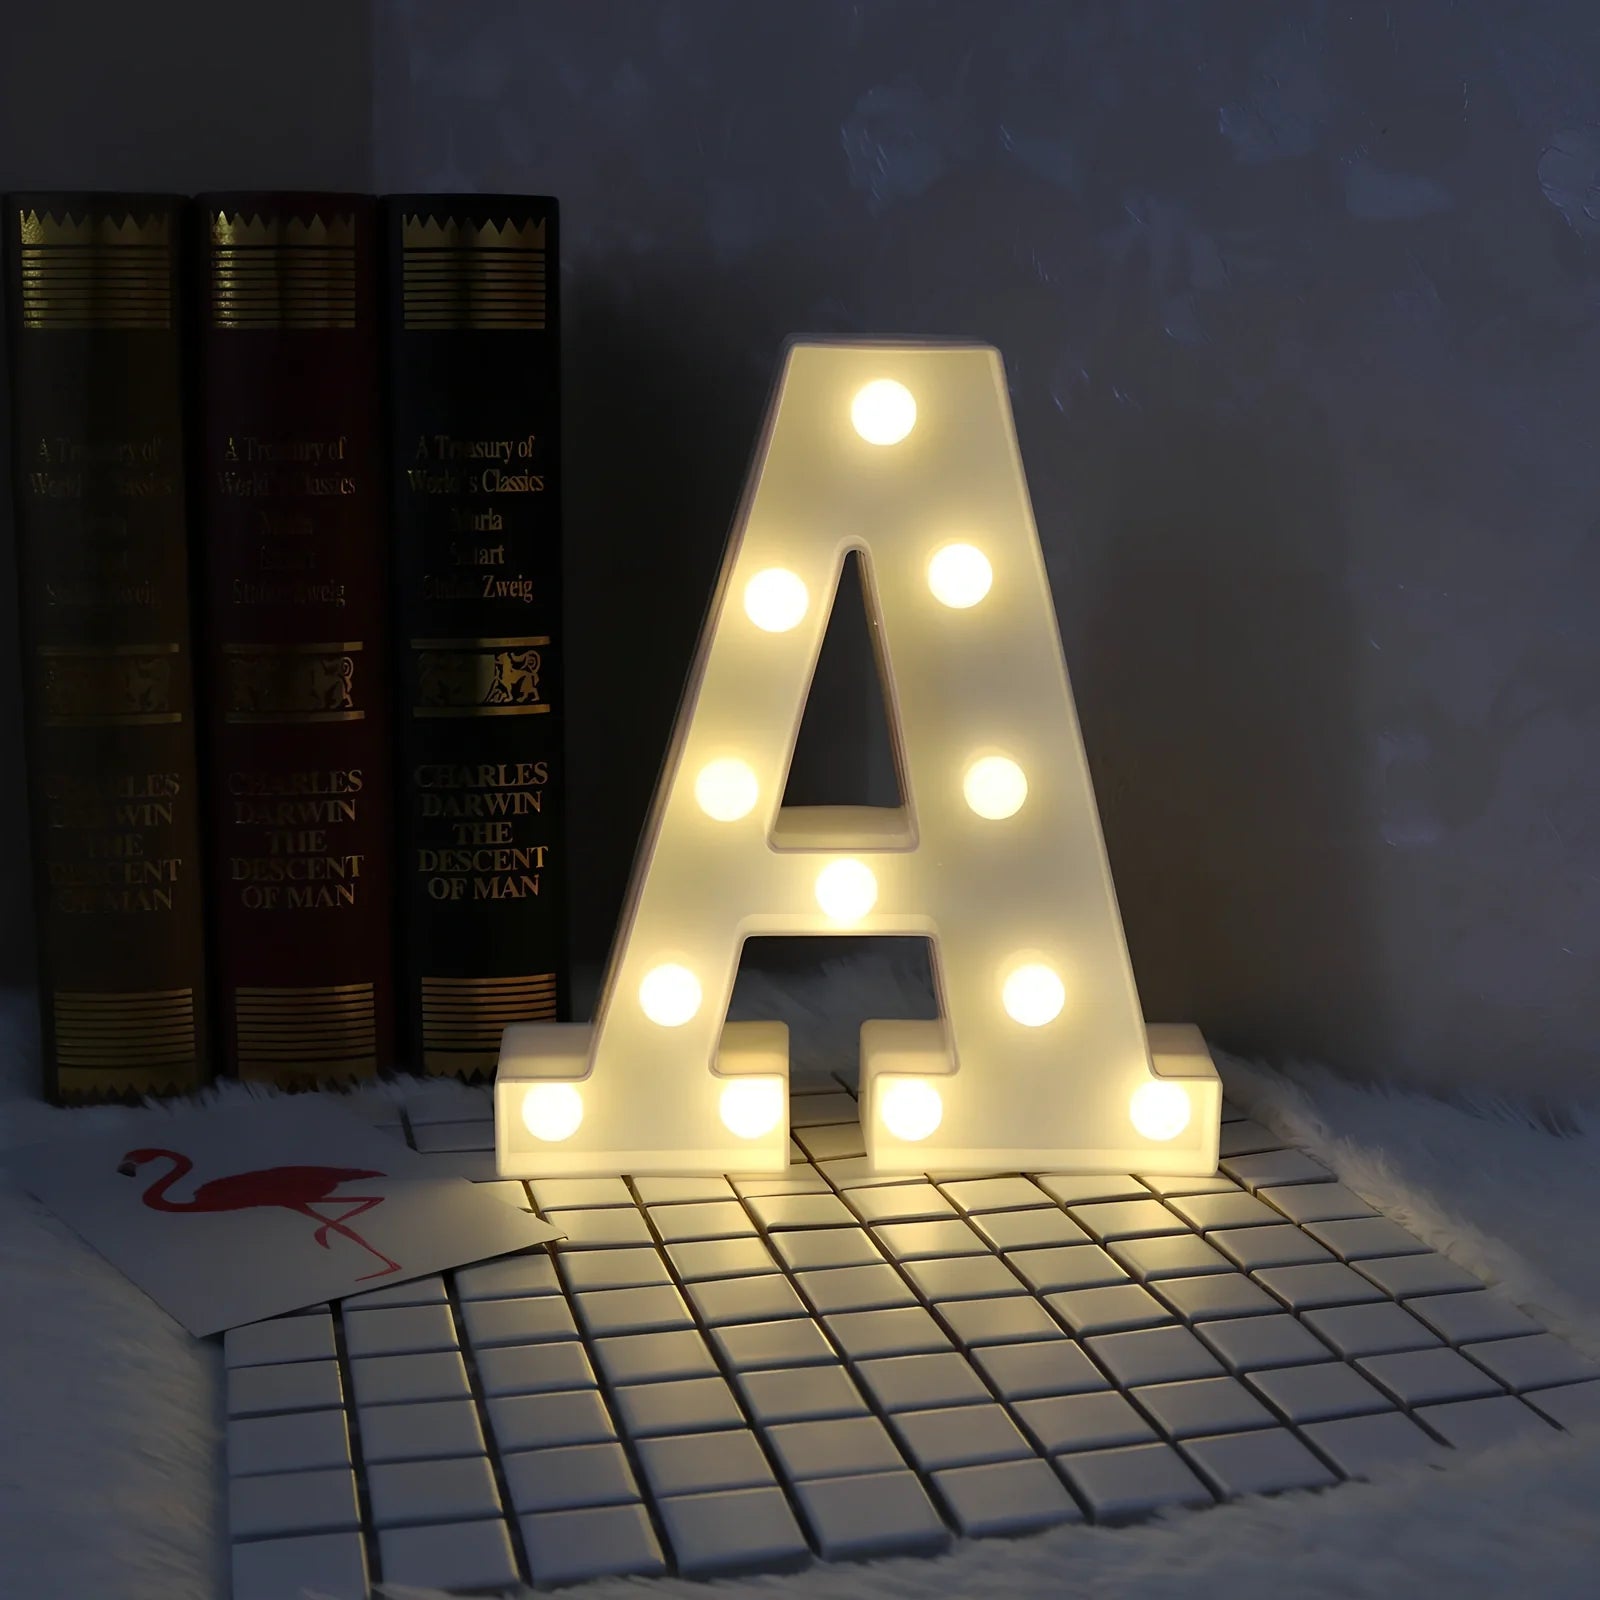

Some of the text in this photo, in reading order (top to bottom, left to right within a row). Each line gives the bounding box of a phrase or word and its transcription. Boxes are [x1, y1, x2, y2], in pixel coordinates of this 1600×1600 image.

[224, 433, 350, 468] A Treury of
[415, 434, 429, 460] A
[516, 432, 536, 460] of
[481, 467, 544, 494] Classics
[481, 573, 535, 604] Zweig
[228, 769, 363, 796] CHARLES
[413, 761, 549, 789] CHARLES
[232, 798, 356, 825] DARWIN
[418, 790, 543, 817] DARWIN
[264, 829, 327, 855] THE
[452, 821, 513, 846] THE
[229, 854, 365, 882] DESCENT
[417, 845, 549, 873] DESCENT
[240, 882, 355, 910] OF MAN
[427, 873, 541, 901] OF MAN
